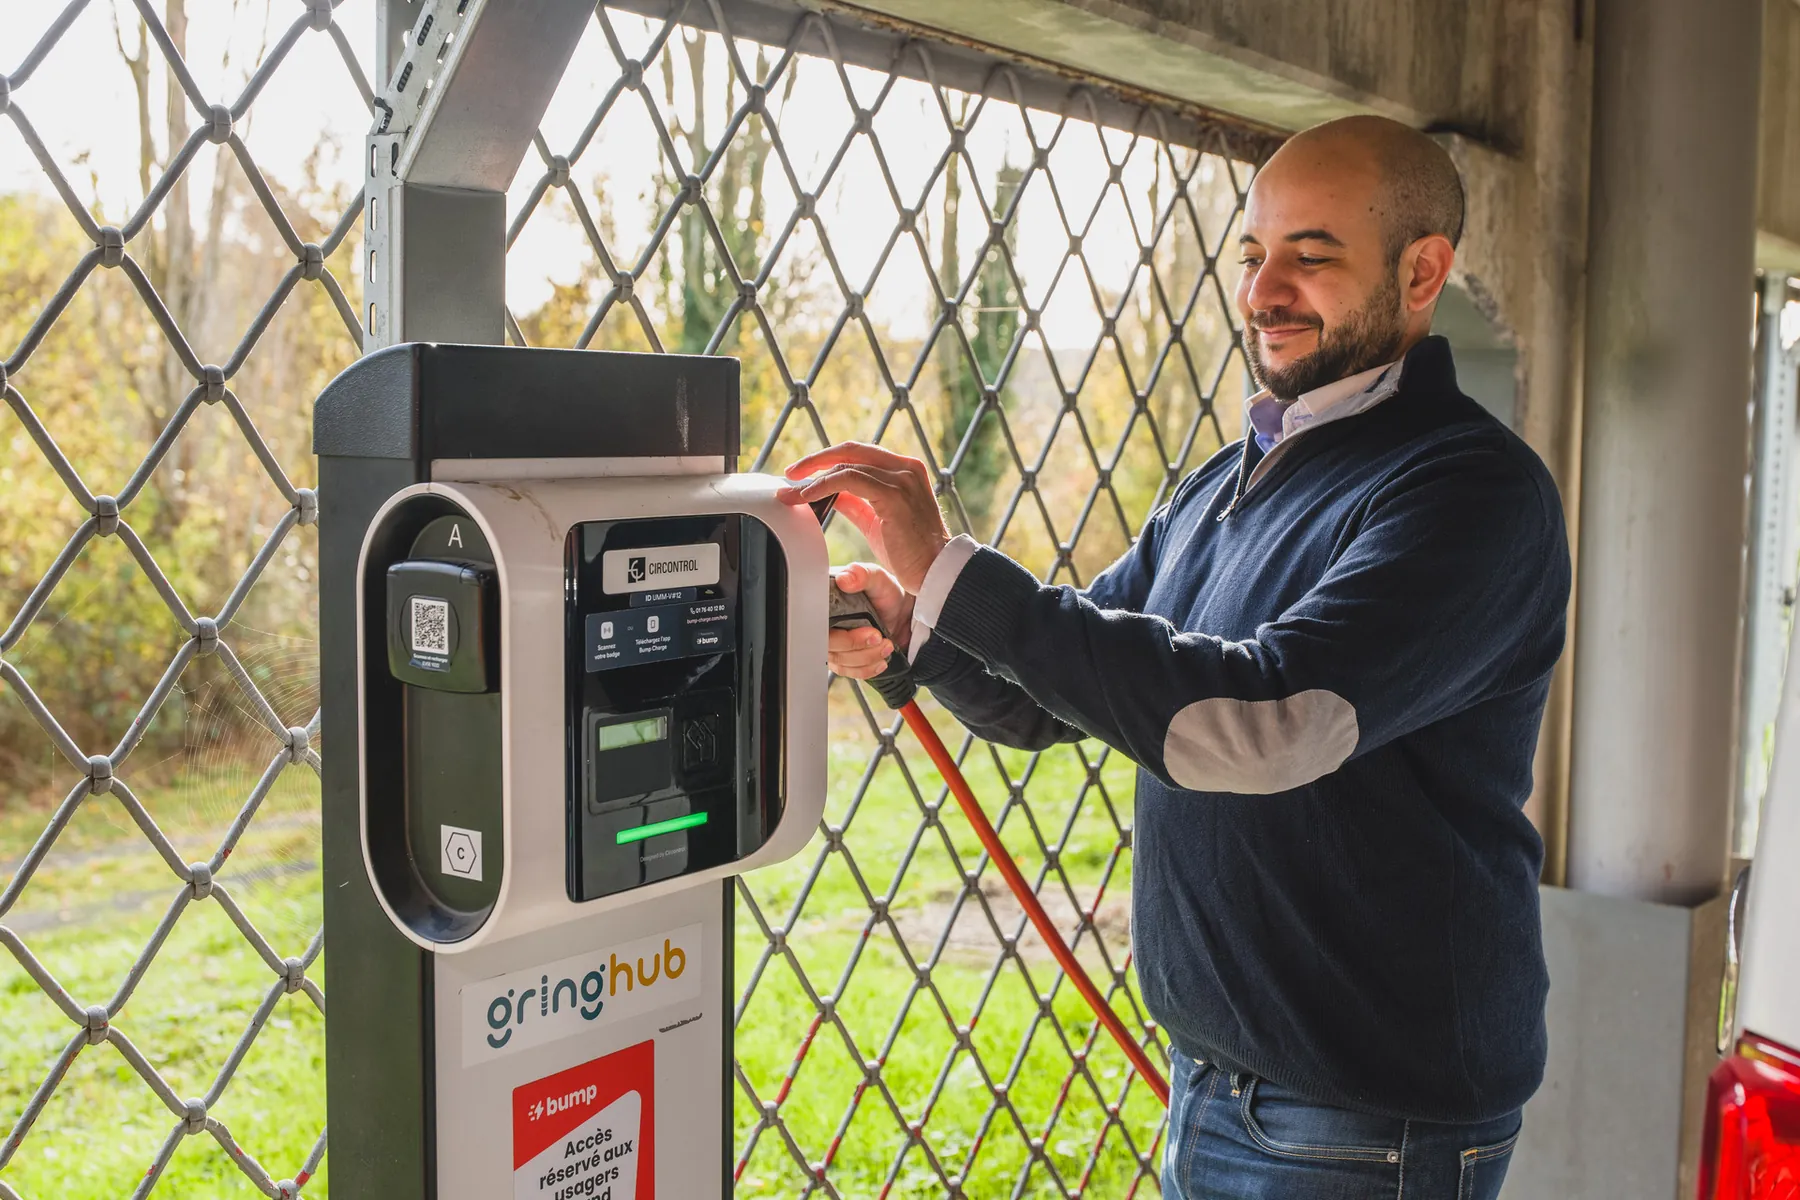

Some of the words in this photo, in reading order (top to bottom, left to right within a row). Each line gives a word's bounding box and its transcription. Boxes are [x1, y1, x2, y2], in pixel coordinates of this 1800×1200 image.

[448, 524, 463, 548] A
[649, 559, 699, 575] CIRCONTROL
[702, 637, 718, 645] bump
[457, 847, 465, 860] C
[487, 938, 686, 1049] gringhub
[546, 1084, 597, 1116] bump
[564, 1128, 612, 1159] Accès
[540, 1149, 601, 1190] réservé
[604, 1140, 633, 1162] aux
[555, 1166, 619, 1200] usagers
